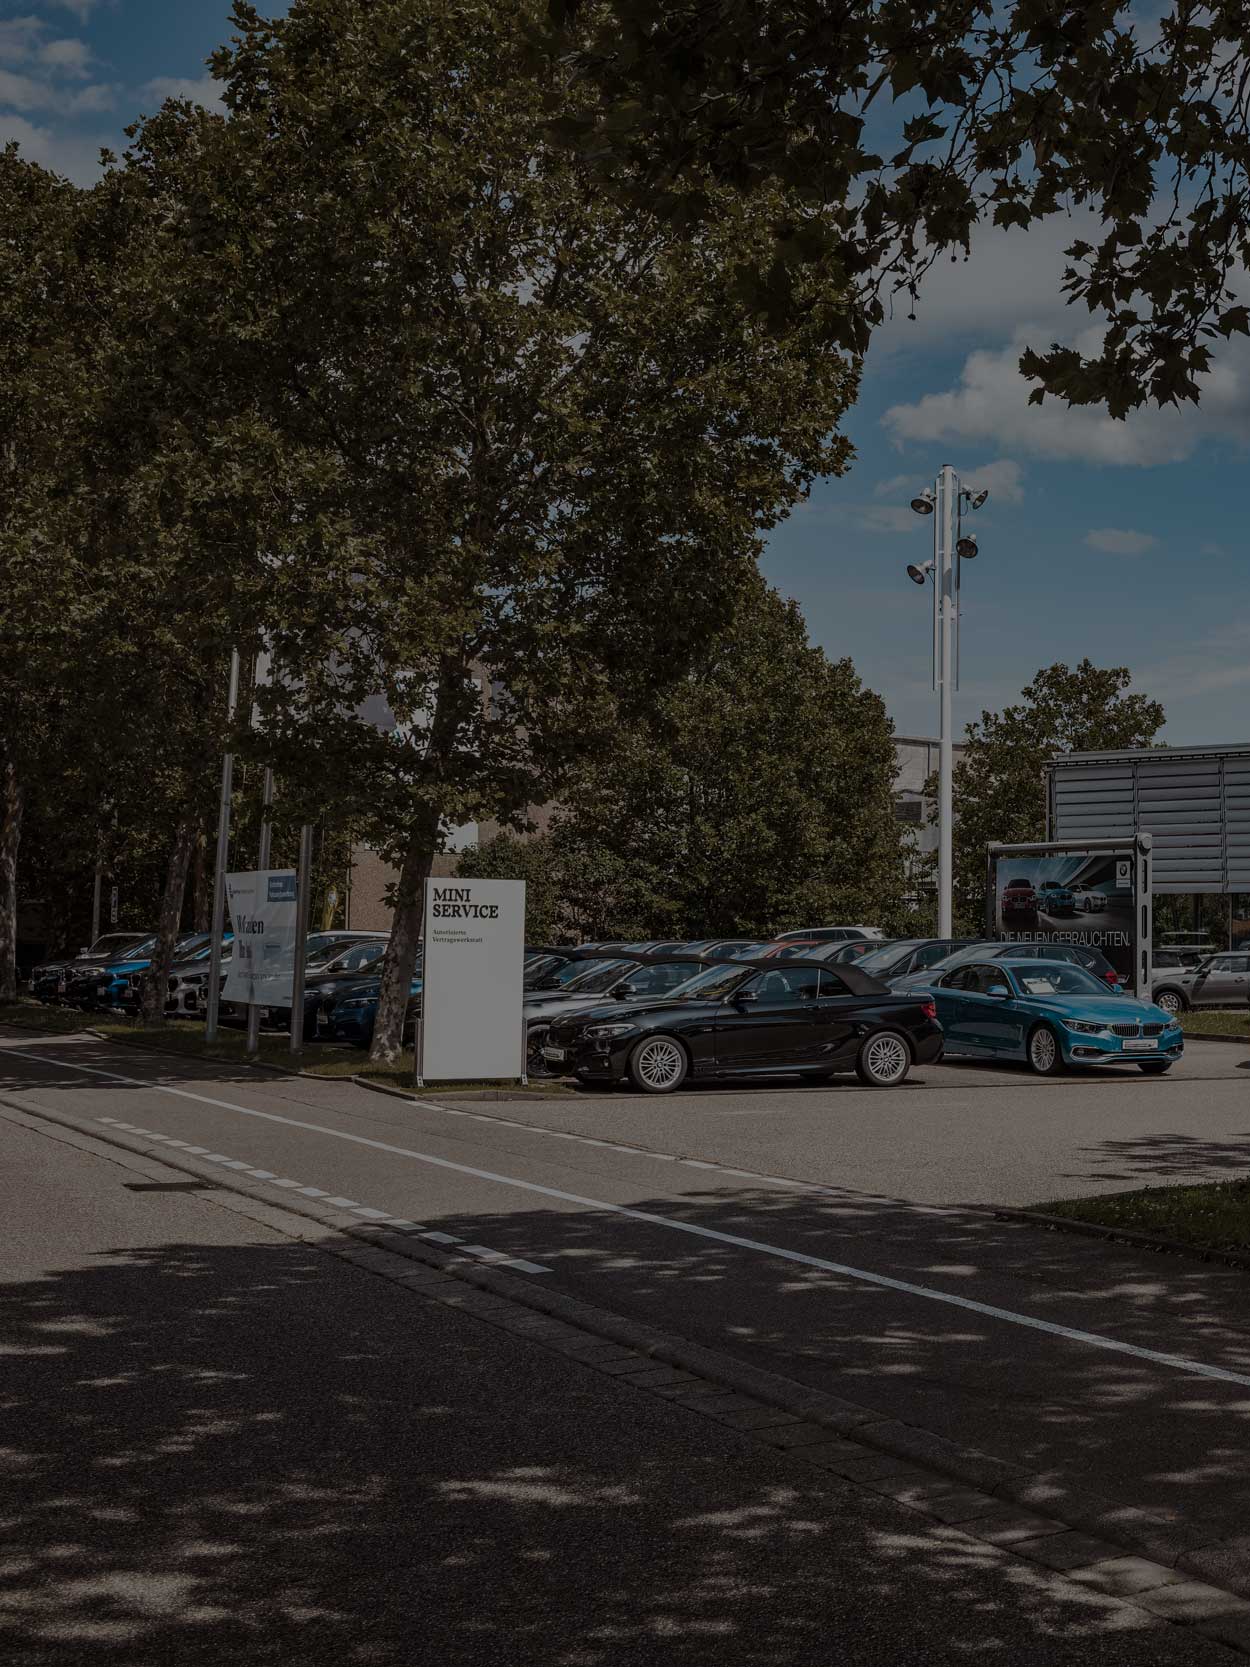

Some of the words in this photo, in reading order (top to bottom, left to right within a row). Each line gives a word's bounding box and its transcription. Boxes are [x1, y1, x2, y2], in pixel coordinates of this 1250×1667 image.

[433, 887, 471, 902] MINI
[433, 903, 499, 918] SERVICE
[1000, 931, 1015, 943] DIE
[1017, 931, 1050, 943] NEUEN
[1051, 931, 1131, 947] GEBRAUCHTEN.
